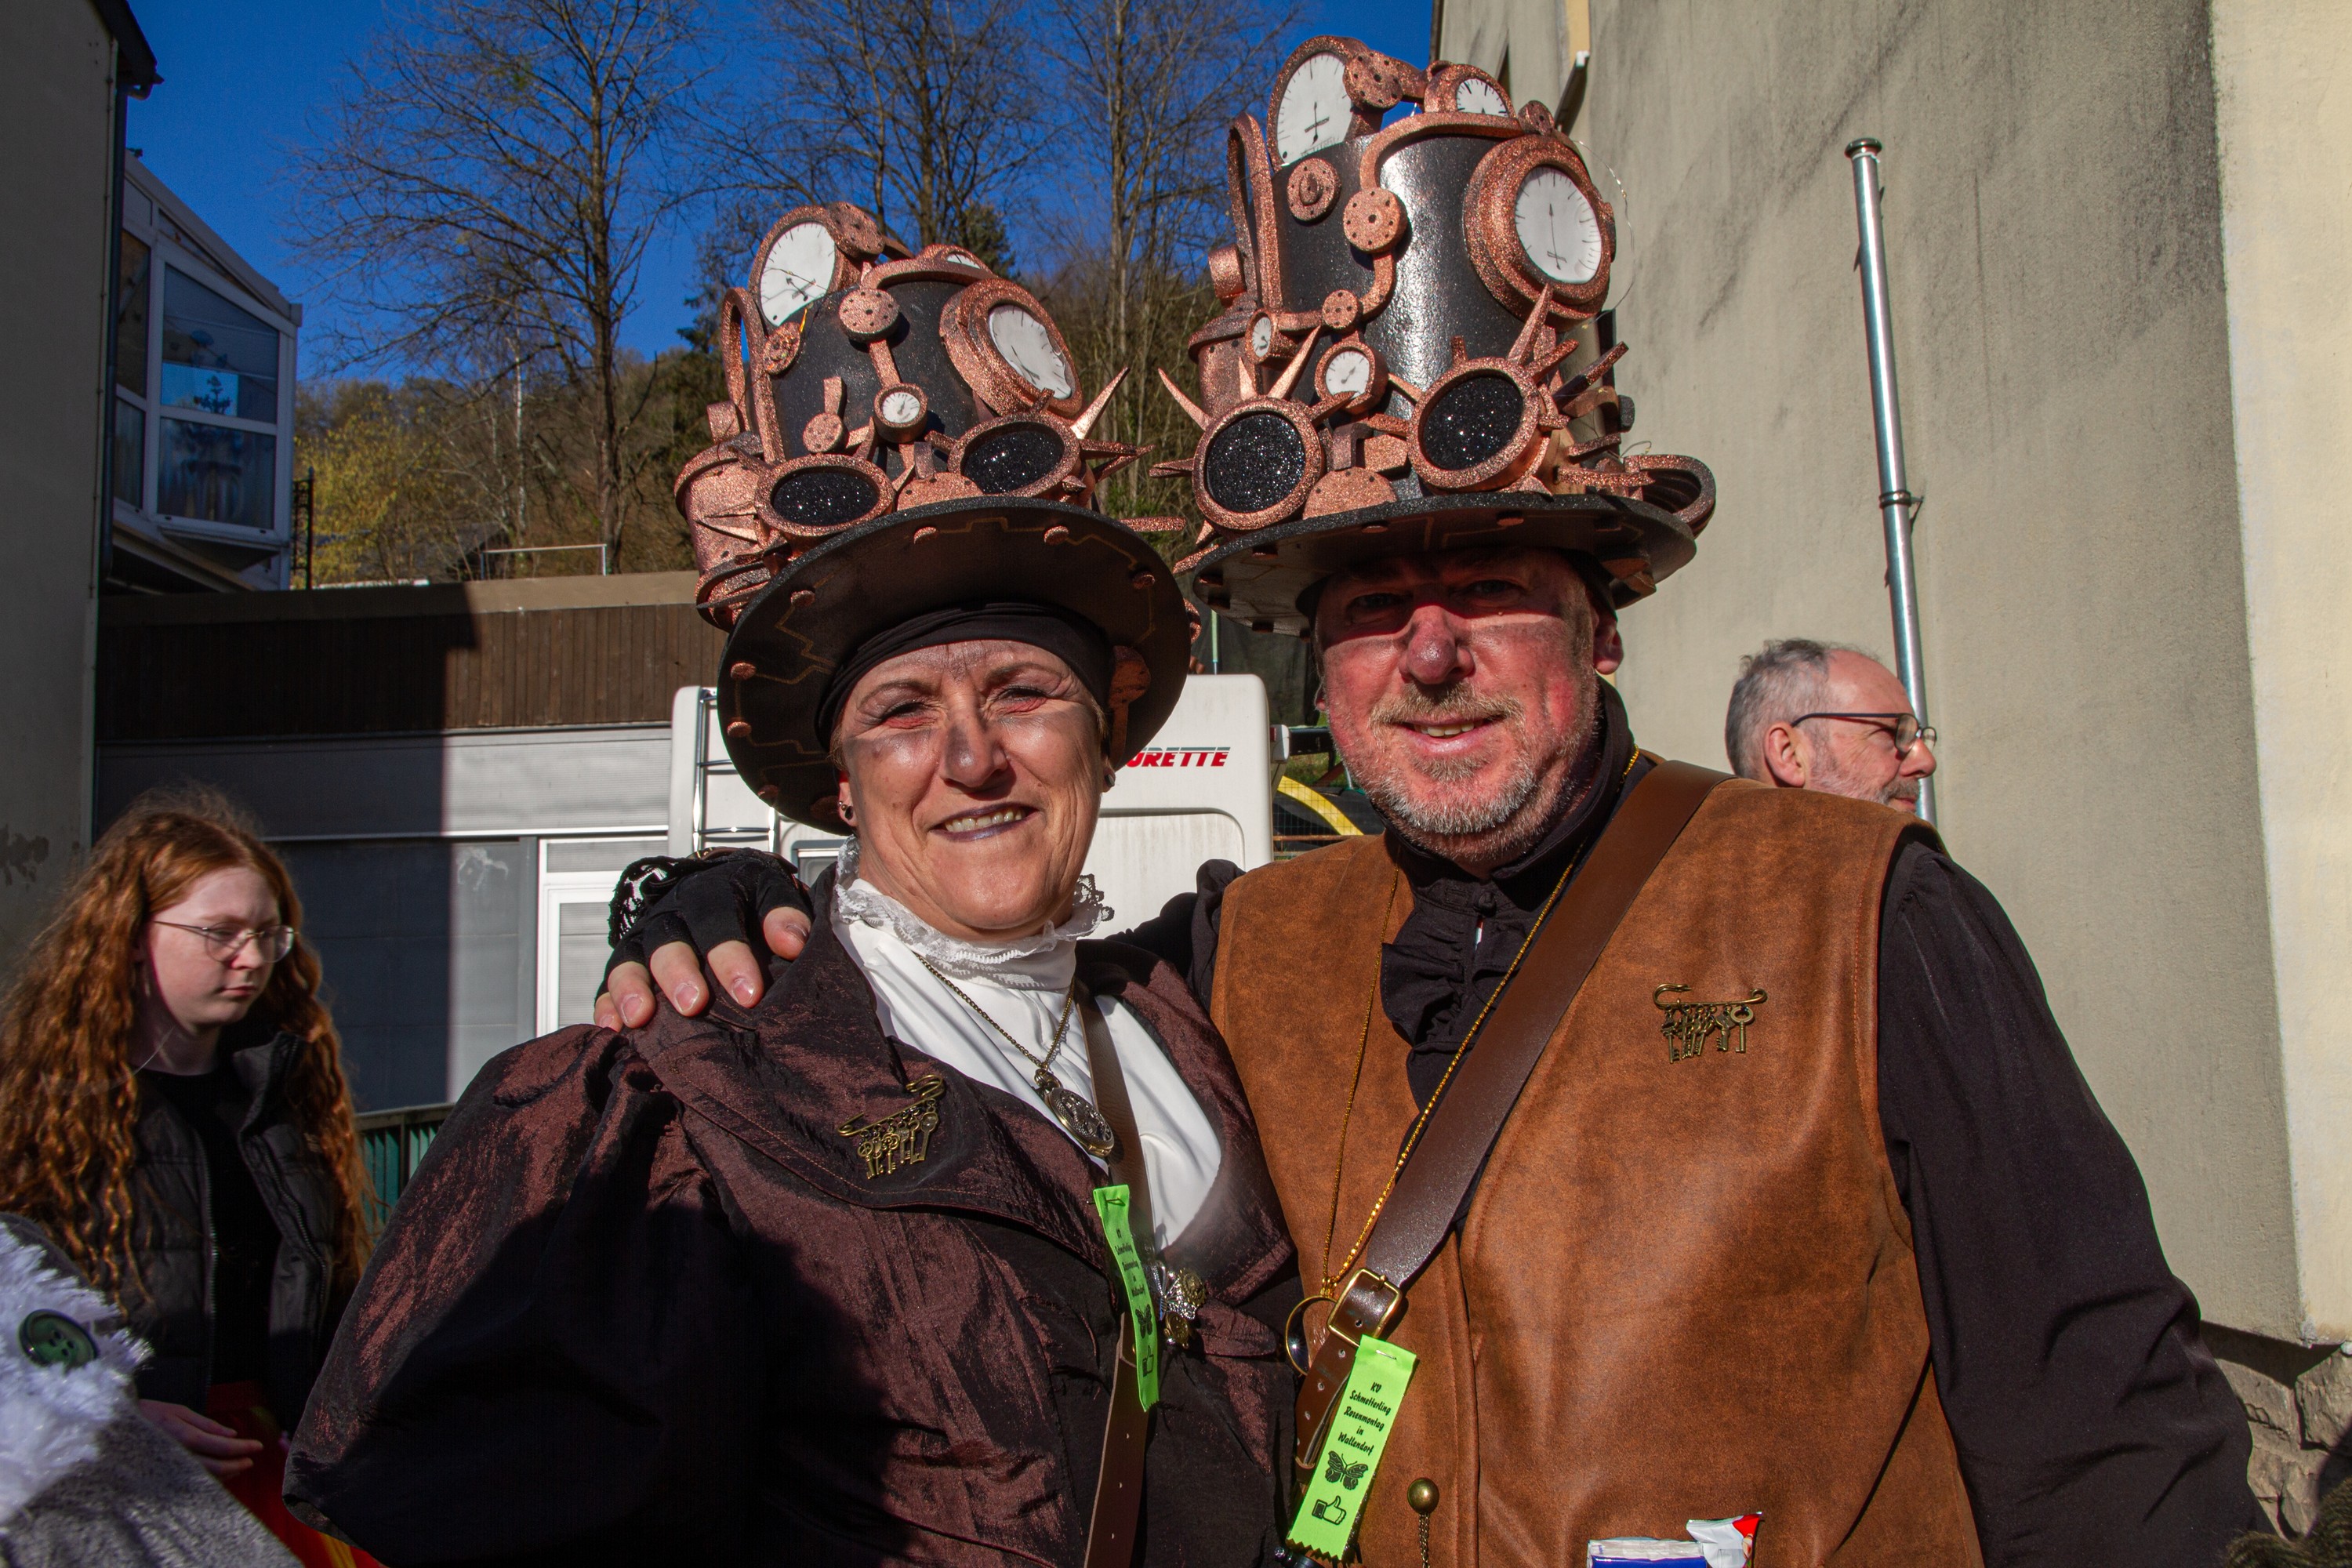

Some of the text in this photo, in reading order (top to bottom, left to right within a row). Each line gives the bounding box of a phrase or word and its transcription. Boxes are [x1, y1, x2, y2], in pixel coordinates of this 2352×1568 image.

[1370, 1381, 1382, 1393] KV
[1349, 1390, 1392, 1416] Schmetterling
[1344, 1406, 1385, 1432] Rosenmontag
[1356, 1425, 1364, 1436] in
[1338, 1432, 1374, 1456] Wallendorf
